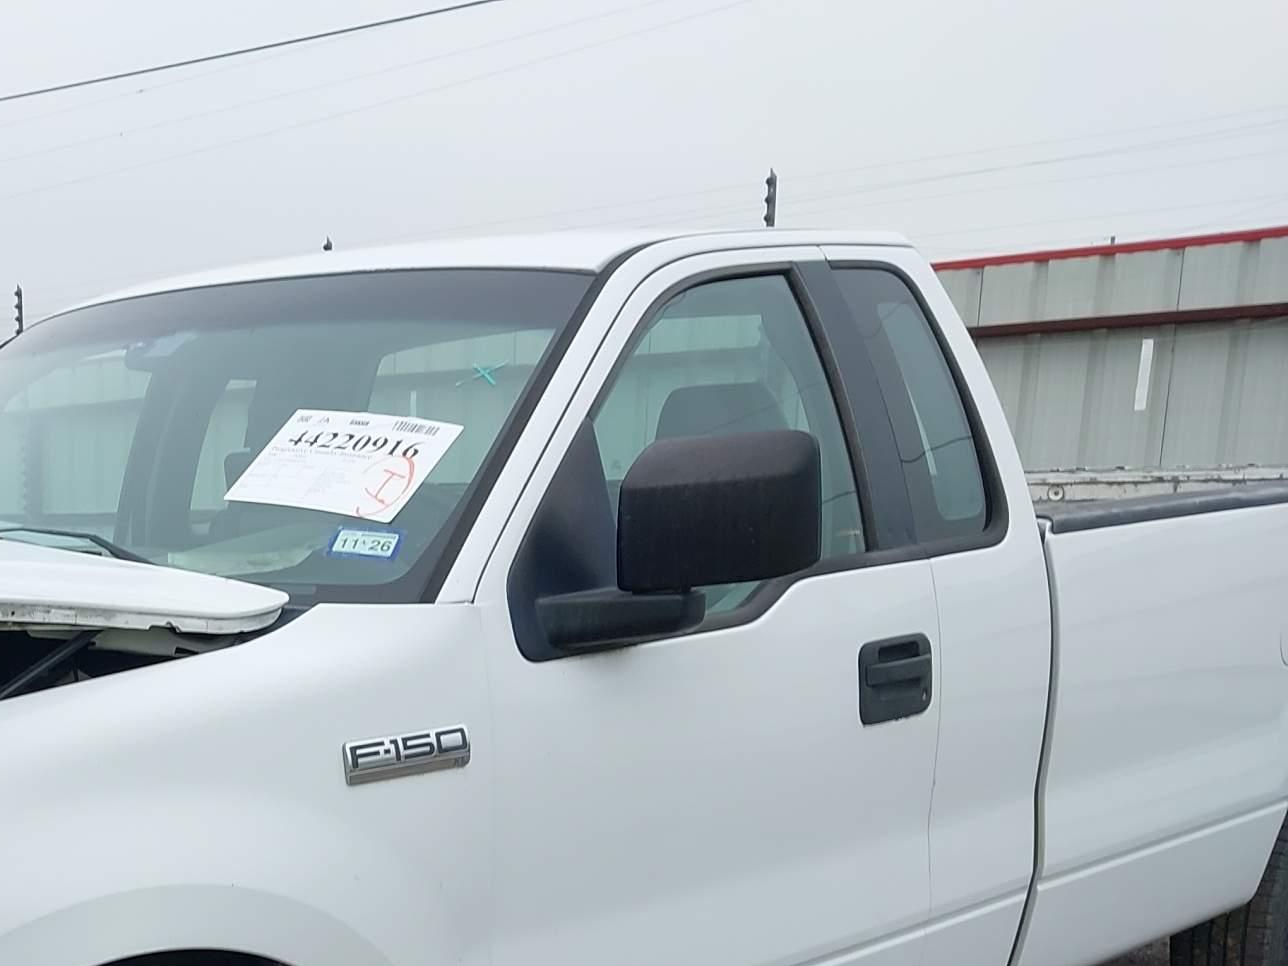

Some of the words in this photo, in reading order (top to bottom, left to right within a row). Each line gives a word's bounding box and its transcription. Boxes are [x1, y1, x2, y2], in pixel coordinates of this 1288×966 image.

[288, 430, 426, 458] 44220916
[341, 536, 359, 550] 11
[368, 539, 393, 552] 26
[348, 727, 468, 769] F-150
